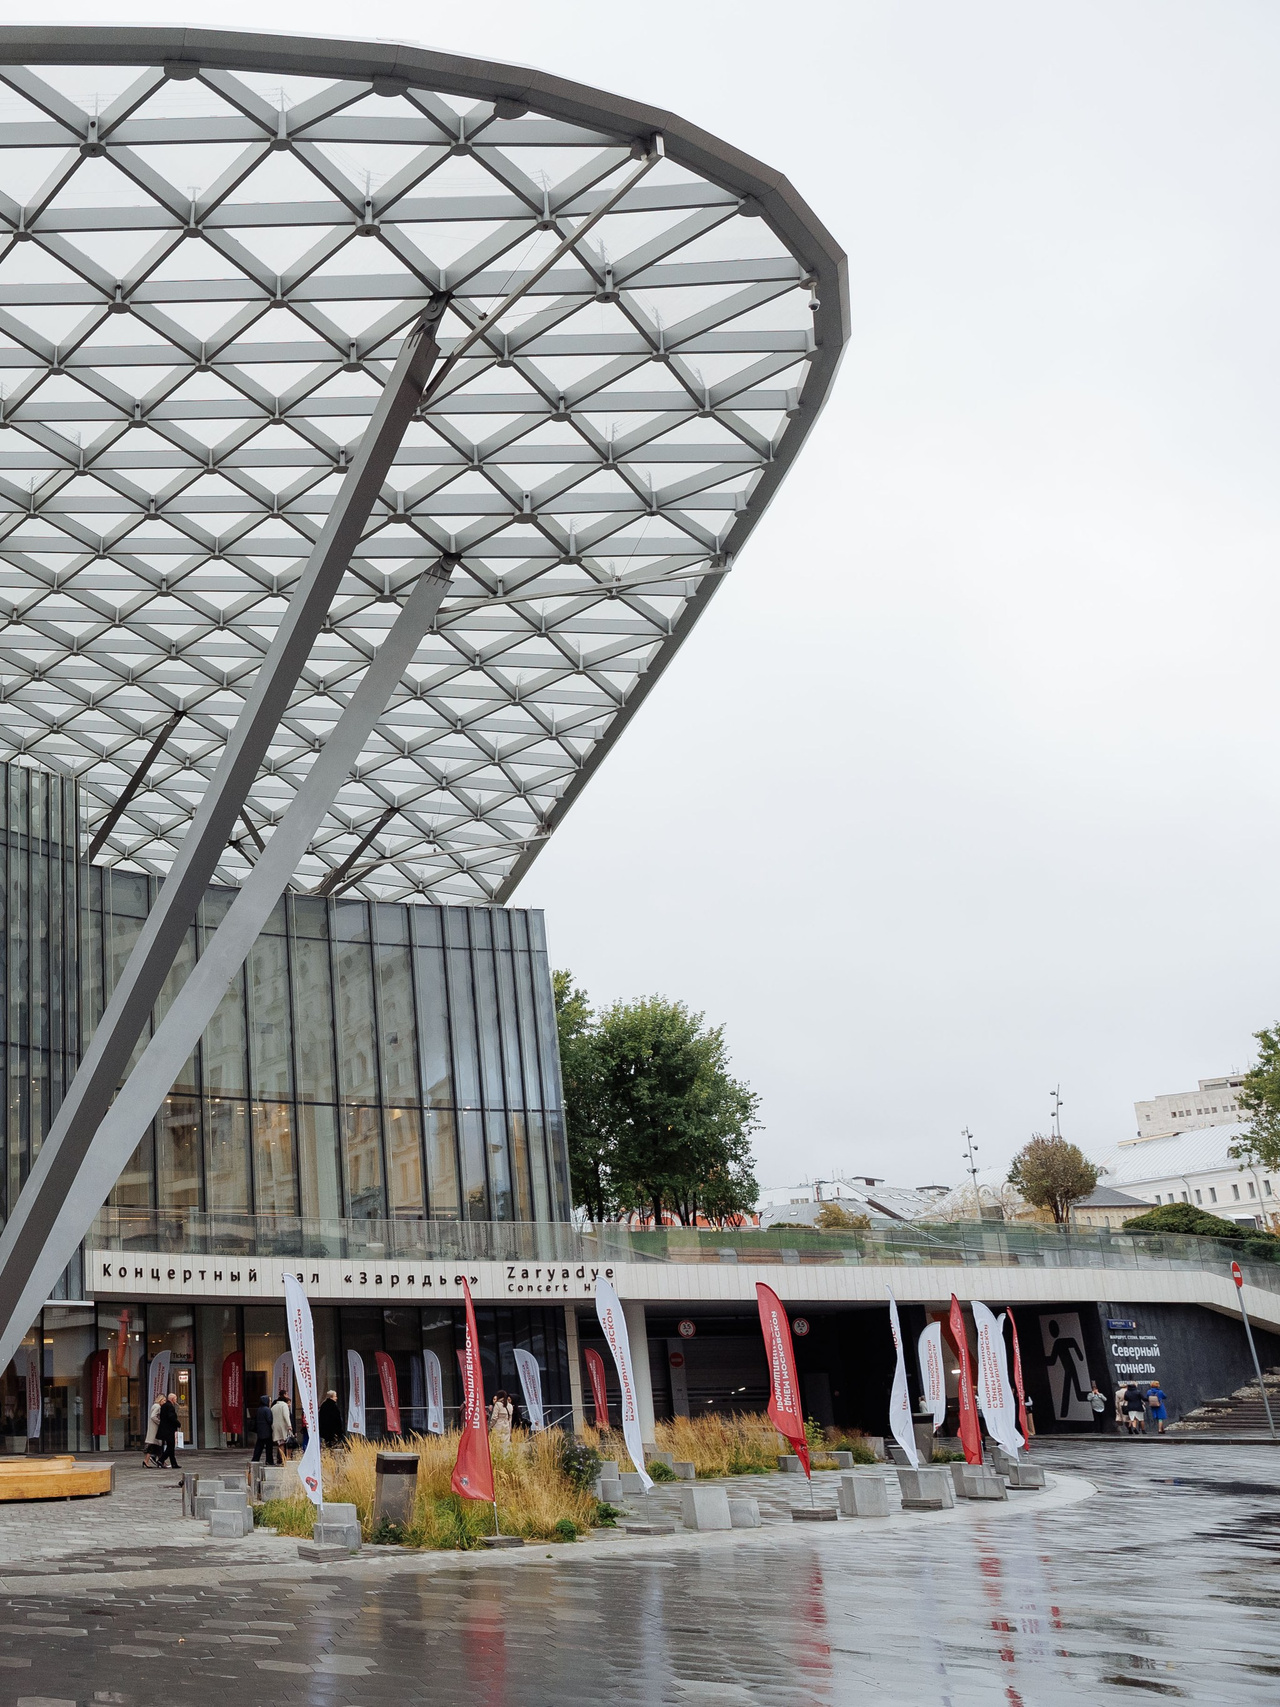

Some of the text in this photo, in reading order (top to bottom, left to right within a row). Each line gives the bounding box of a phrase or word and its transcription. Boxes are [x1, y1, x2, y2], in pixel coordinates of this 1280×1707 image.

[102, 1263, 258, 1284] Концертный
[344, 1271, 479, 1288] «Зарядье»
[507, 1264, 614, 1283] Zaryadye
[508, 1282, 568, 1292] Concert
[1112, 1344, 1160, 1360] Северный
[1114, 1363, 1156, 1374] тоннель
